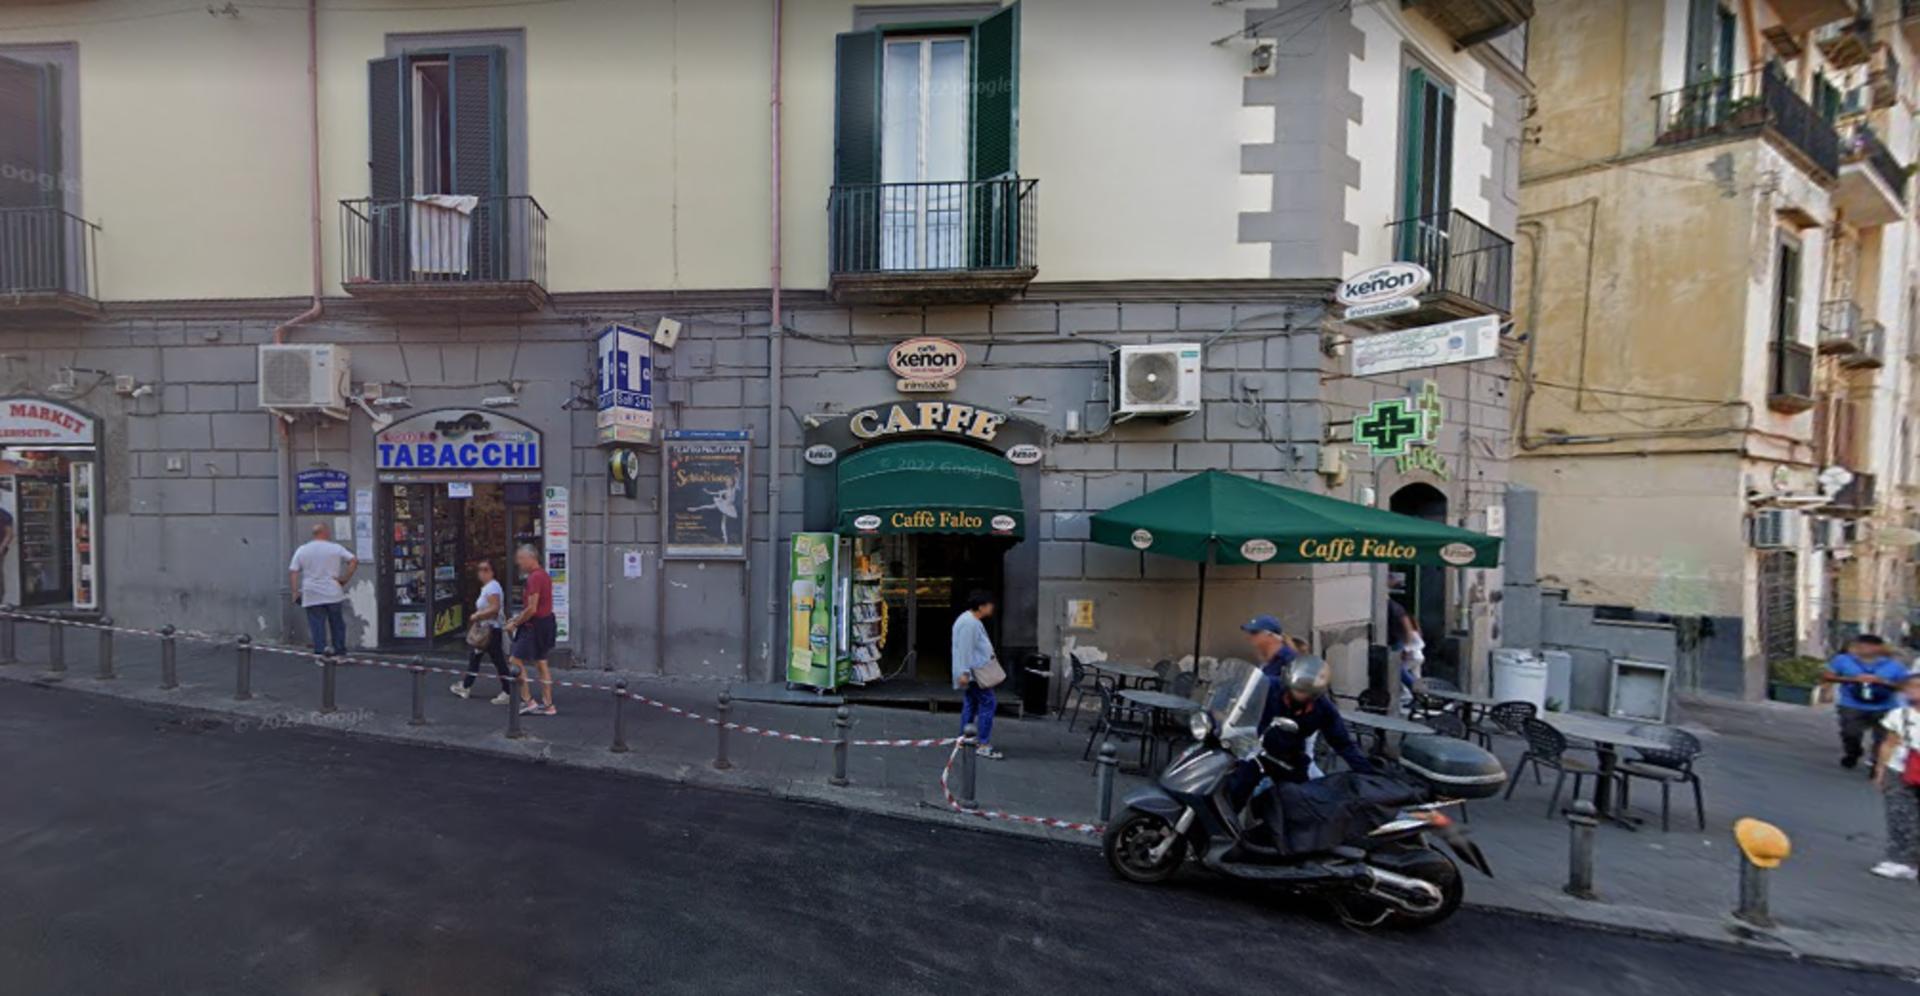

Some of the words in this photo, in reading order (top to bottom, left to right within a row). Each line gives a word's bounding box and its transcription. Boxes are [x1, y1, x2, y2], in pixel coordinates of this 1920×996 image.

[1345, 272, 1415, 299] kenon
[618, 331, 650, 392] T
[896, 351, 957, 367] kenon
[903, 379, 950, 391] inimitabile
[9, 403, 86, 434] MARKET
[378, 443, 537, 467] TABACCHI
[891, 511, 935, 528] Caffè
[939, 511, 983, 528] Falco
[1299, 537, 1356, 562] Caffè
[1360, 539, 1417, 559] Falco
